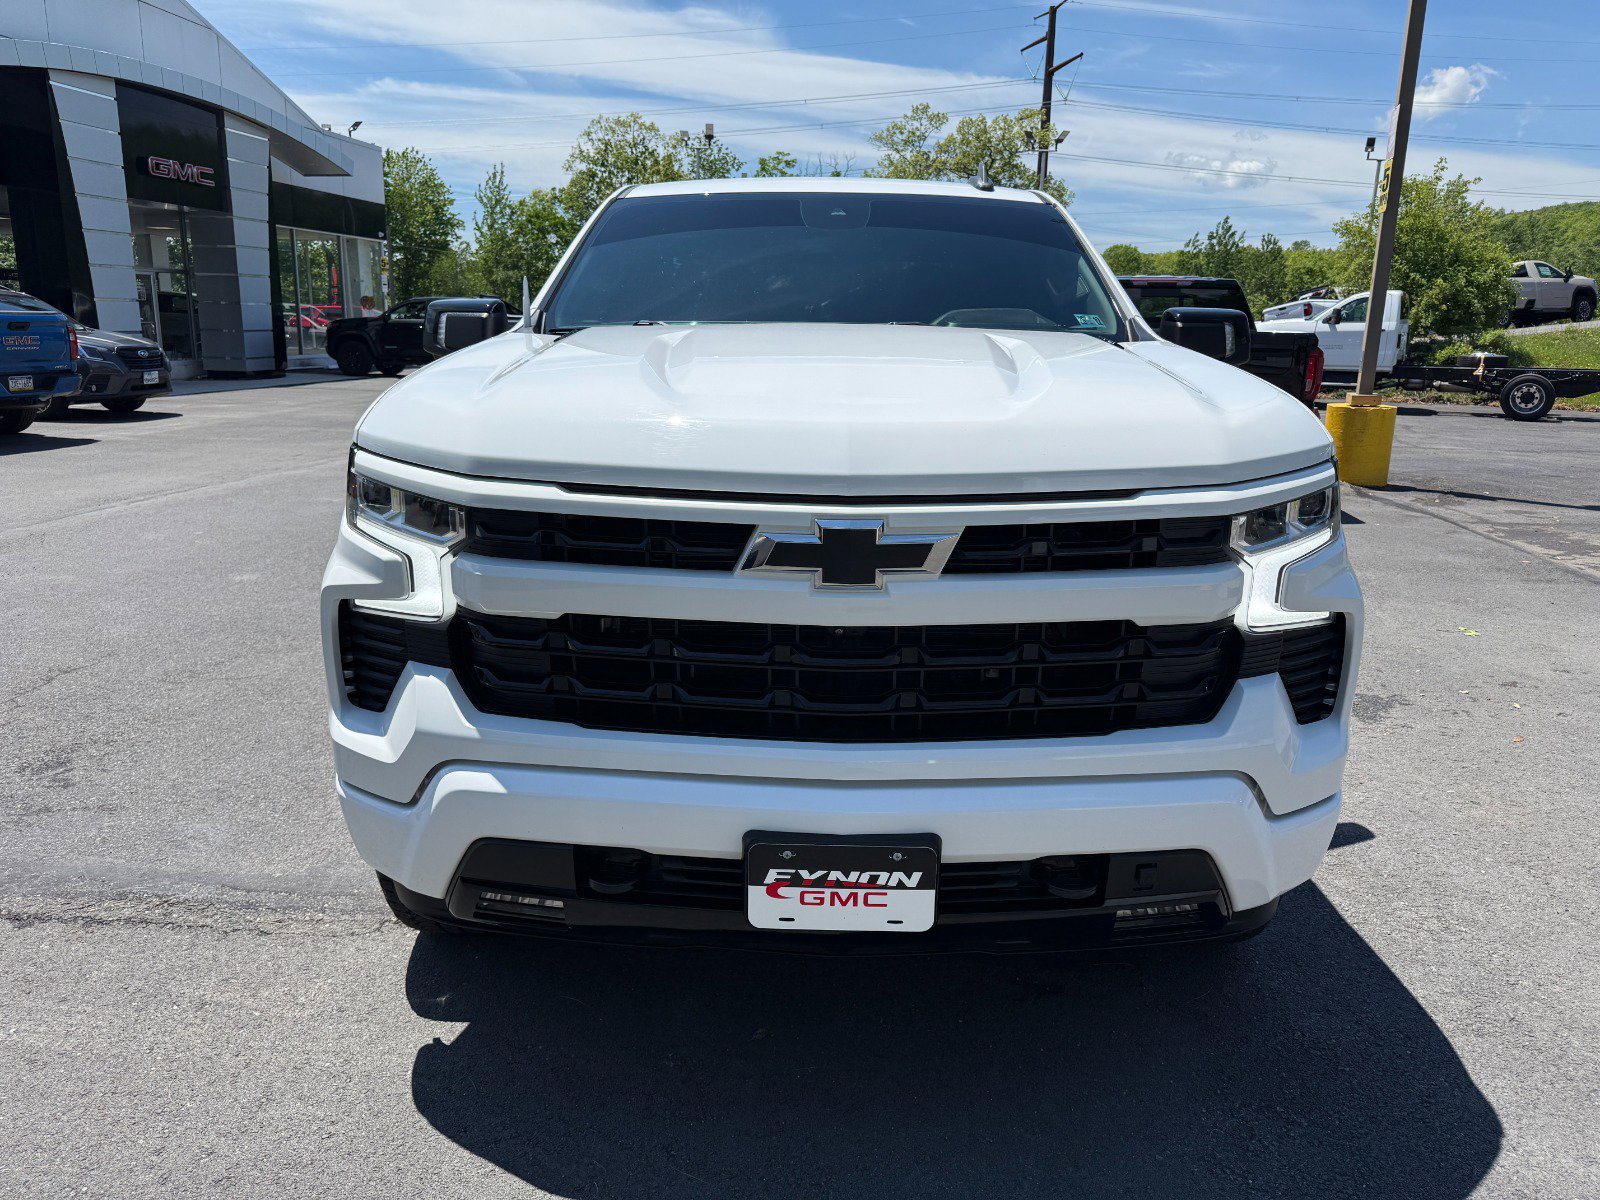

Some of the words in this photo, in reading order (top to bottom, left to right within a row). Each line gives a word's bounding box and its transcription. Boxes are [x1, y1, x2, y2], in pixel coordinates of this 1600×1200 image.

[148, 156, 215, 186] GMC
[3, 335, 41, 346] GMC
[800, 891, 888, 907] GMC
